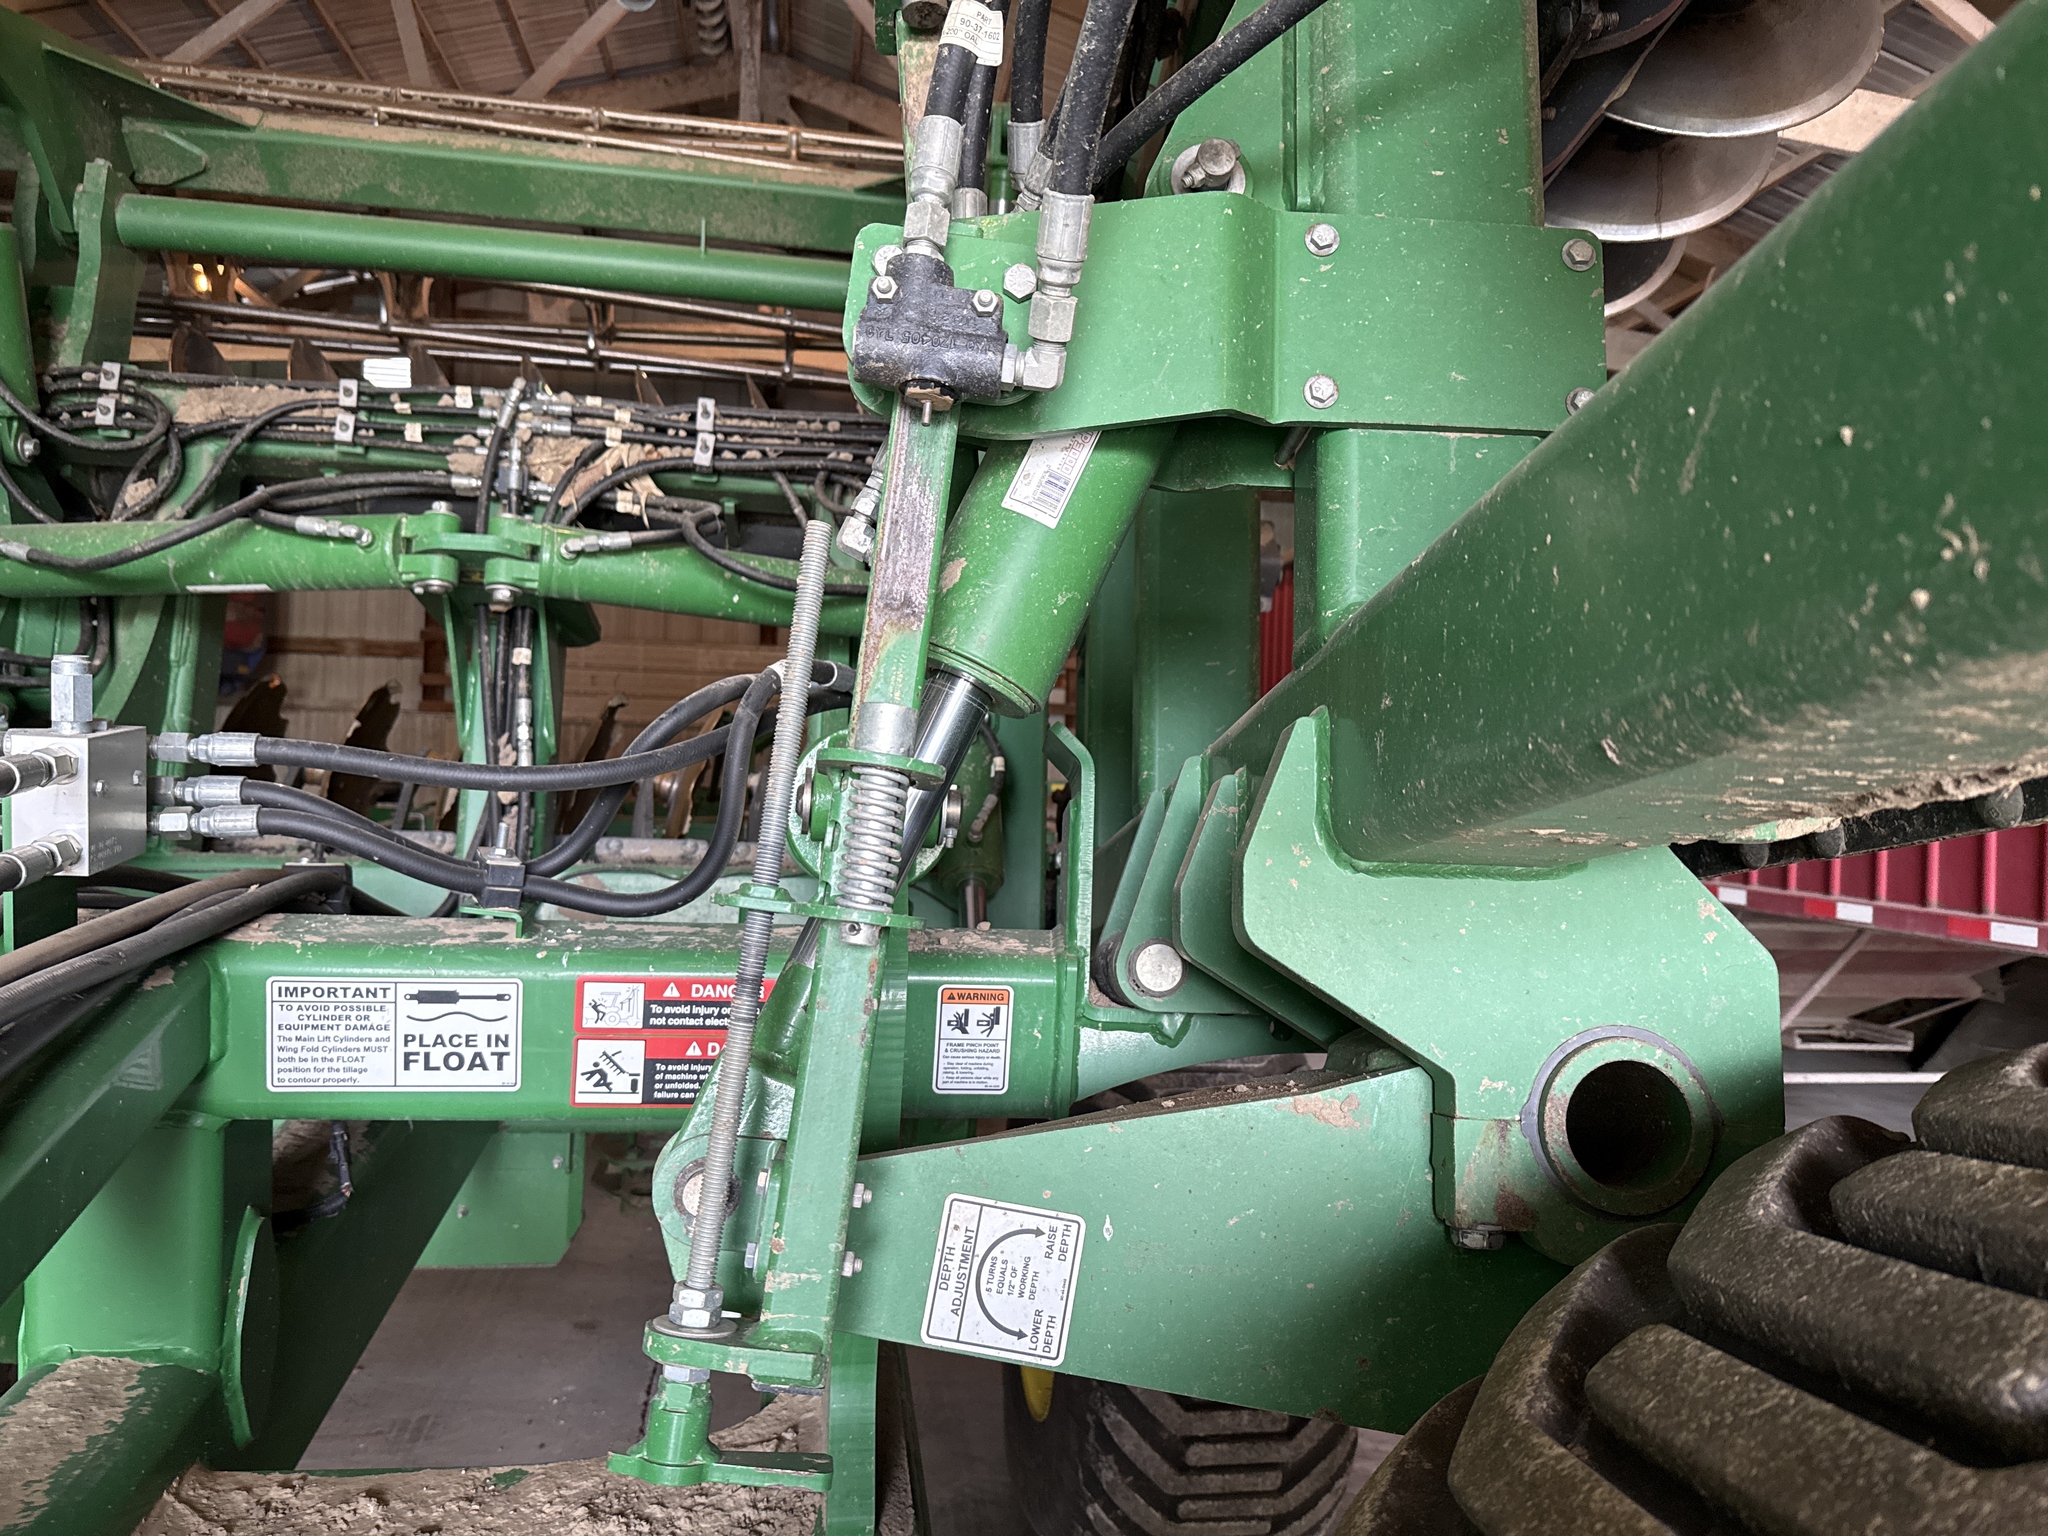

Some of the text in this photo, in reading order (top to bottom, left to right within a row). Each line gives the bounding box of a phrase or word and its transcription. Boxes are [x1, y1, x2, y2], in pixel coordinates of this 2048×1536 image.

[977, 11, 992, 24] PART
[960, 18, 1000, 40] 90-37-1602
[964, 32, 979, 45] OAL
[278, 986, 390, 999] IMPORTANT
[691, 984, 764, 997] DANGR
[957, 993, 1004, 1001] WARNING
[650, 1005, 662, 1013] To
[665, 1005, 691, 1014] avoid
[693, 1005, 720, 1015] injury
[334, 1035, 372, 1044] Cylinders
[404, 1034, 509, 1047] PLACE IN
[277, 1045, 298, 1054] Wing
[322, 1046, 360, 1054] Cylinders
[404, 1052, 510, 1071] FLOAT
[691, 1064, 712, 1072] injury
[277, 1066, 311, 1074] position
[343, 1066, 368, 1075] tillage
[322, 1077, 359, 1085] properly.
[1045, 1225, 1058, 1259] RAISE
[1058, 1224, 1071, 1261] DEPTH
[939, 1246, 956, 1291] DEPTH
[951, 1226, 974, 1316] ADJUSTMENT
[987, 1256, 998, 1285] TURNS
[1011, 1266, 1018, 1278] OF
[996, 1259, 1008, 1294] EQUALS
[1018, 1256, 1031, 1298] WORKING
[1029, 1271, 1039, 1300] DEPTH
[1029, 1309, 1043, 1351] LOWER
[1043, 1316, 1056, 1353] DEPTH
